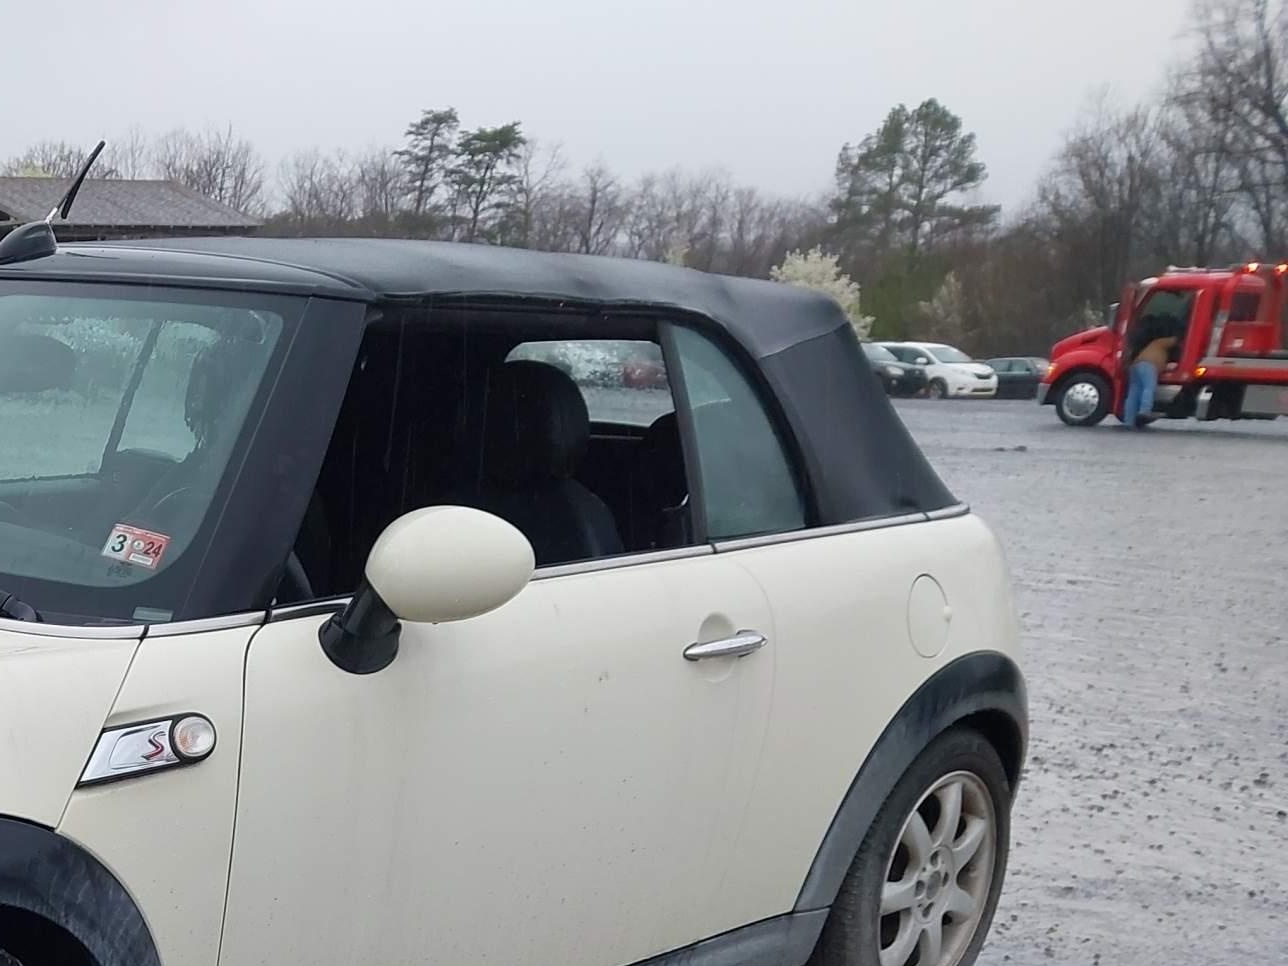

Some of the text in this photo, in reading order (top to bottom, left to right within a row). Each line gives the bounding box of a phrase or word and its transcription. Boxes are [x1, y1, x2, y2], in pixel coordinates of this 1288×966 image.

[111, 533, 128, 553] 3
[143, 541, 163, 558] 24
[141, 731, 167, 760] S
